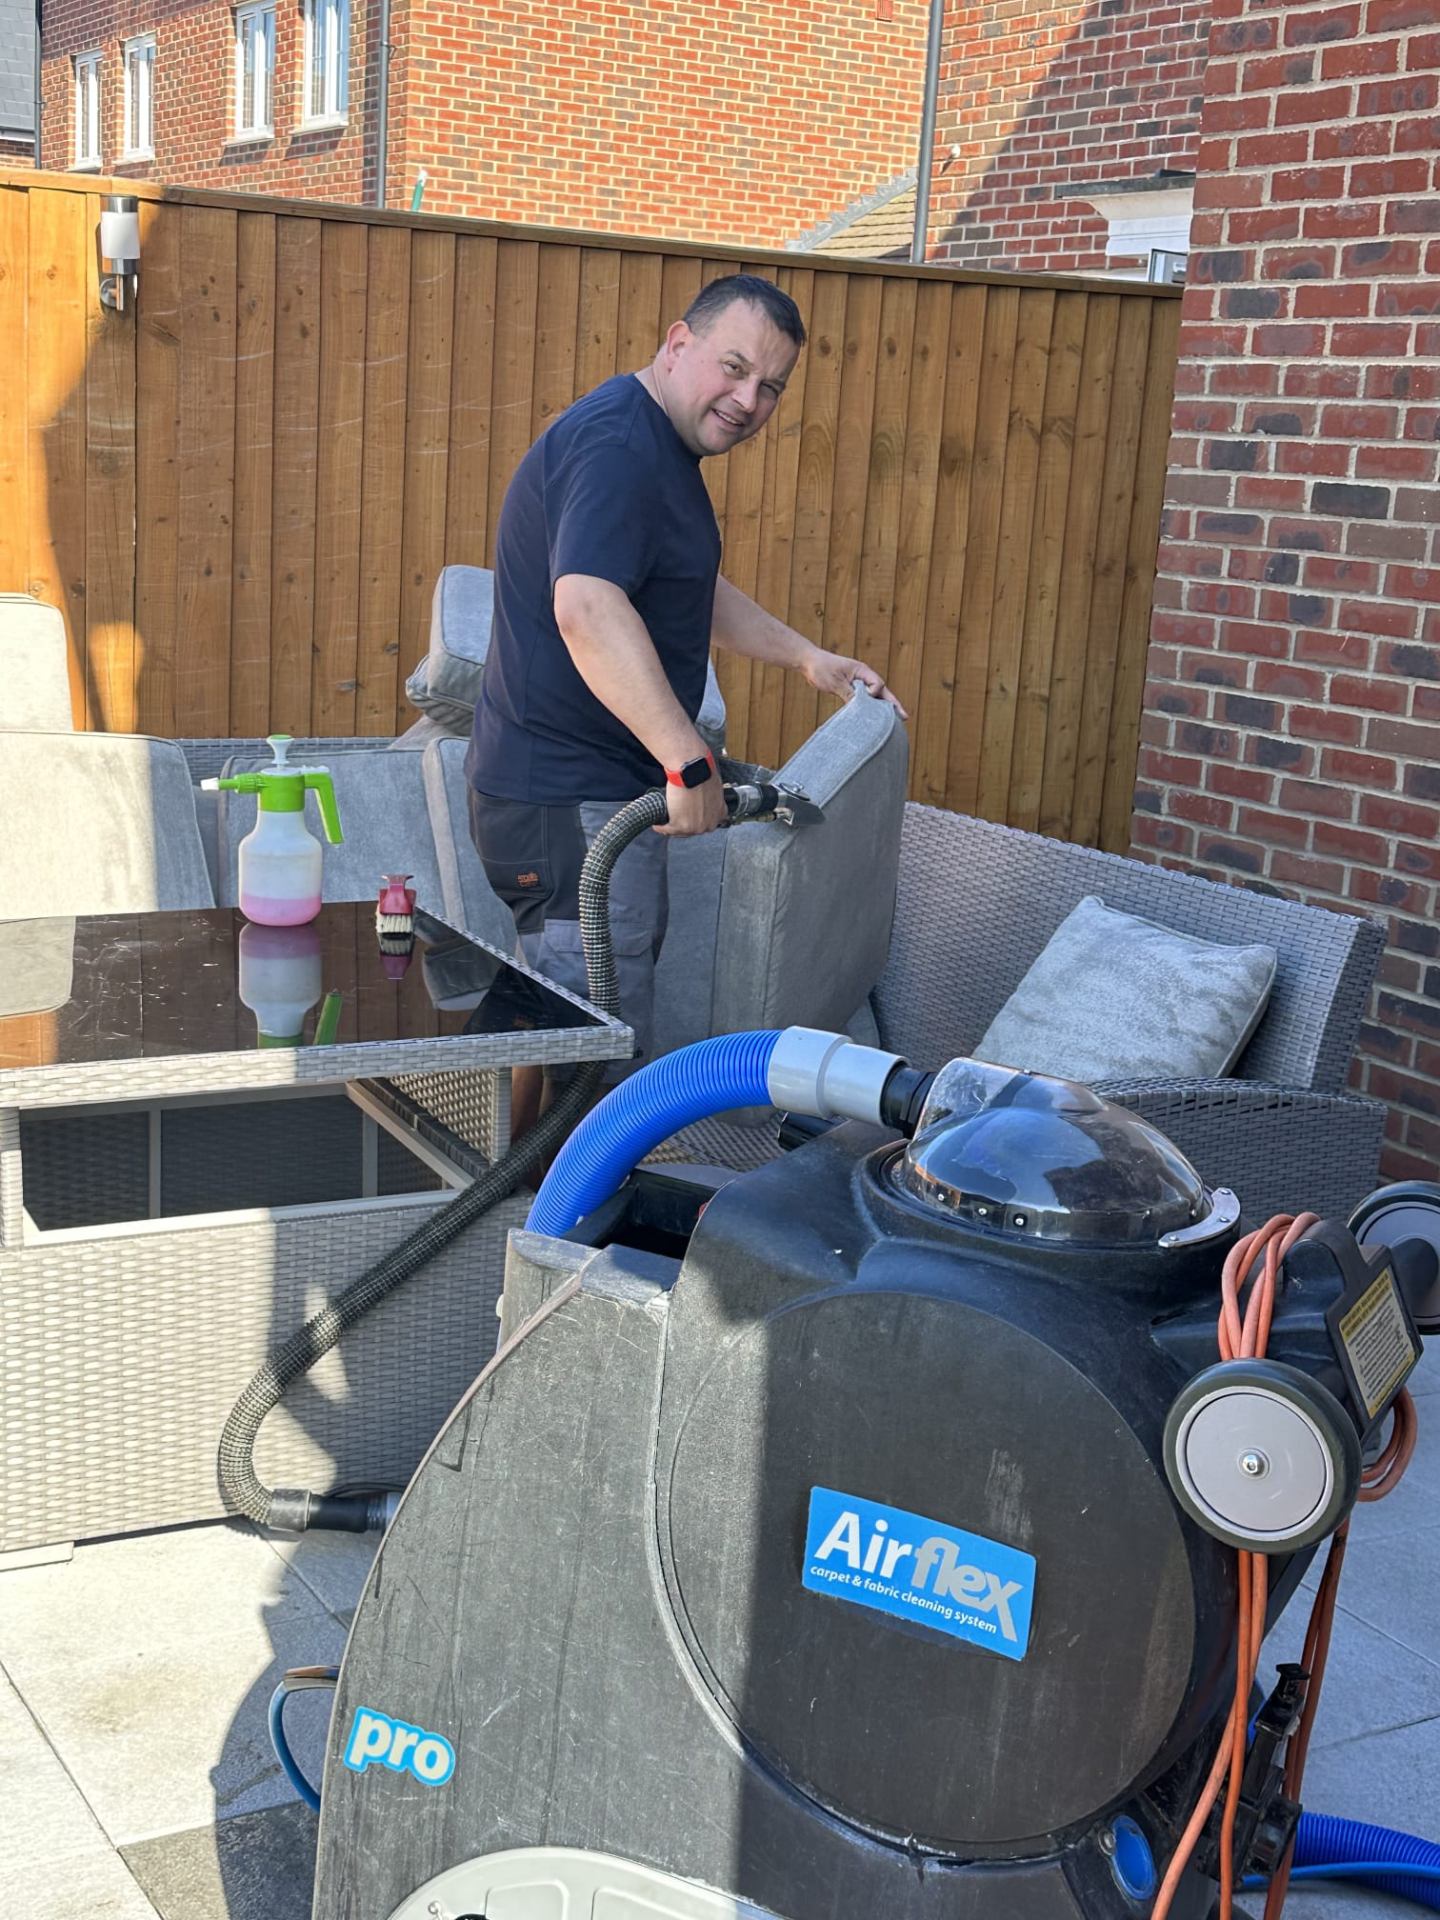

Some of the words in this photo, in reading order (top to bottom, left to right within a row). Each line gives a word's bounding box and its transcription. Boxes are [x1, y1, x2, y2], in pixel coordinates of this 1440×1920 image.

[810, 1566, 850, 1582] carpet
[851, 1575, 862, 1587] &
[864, 1578, 900, 1599] fabric
[901, 1592, 953, 1619] cleaning
[954, 1611, 997, 1634] system
[814, 1511, 1023, 1642] Airflex
[348, 1714, 450, 1780] pro
